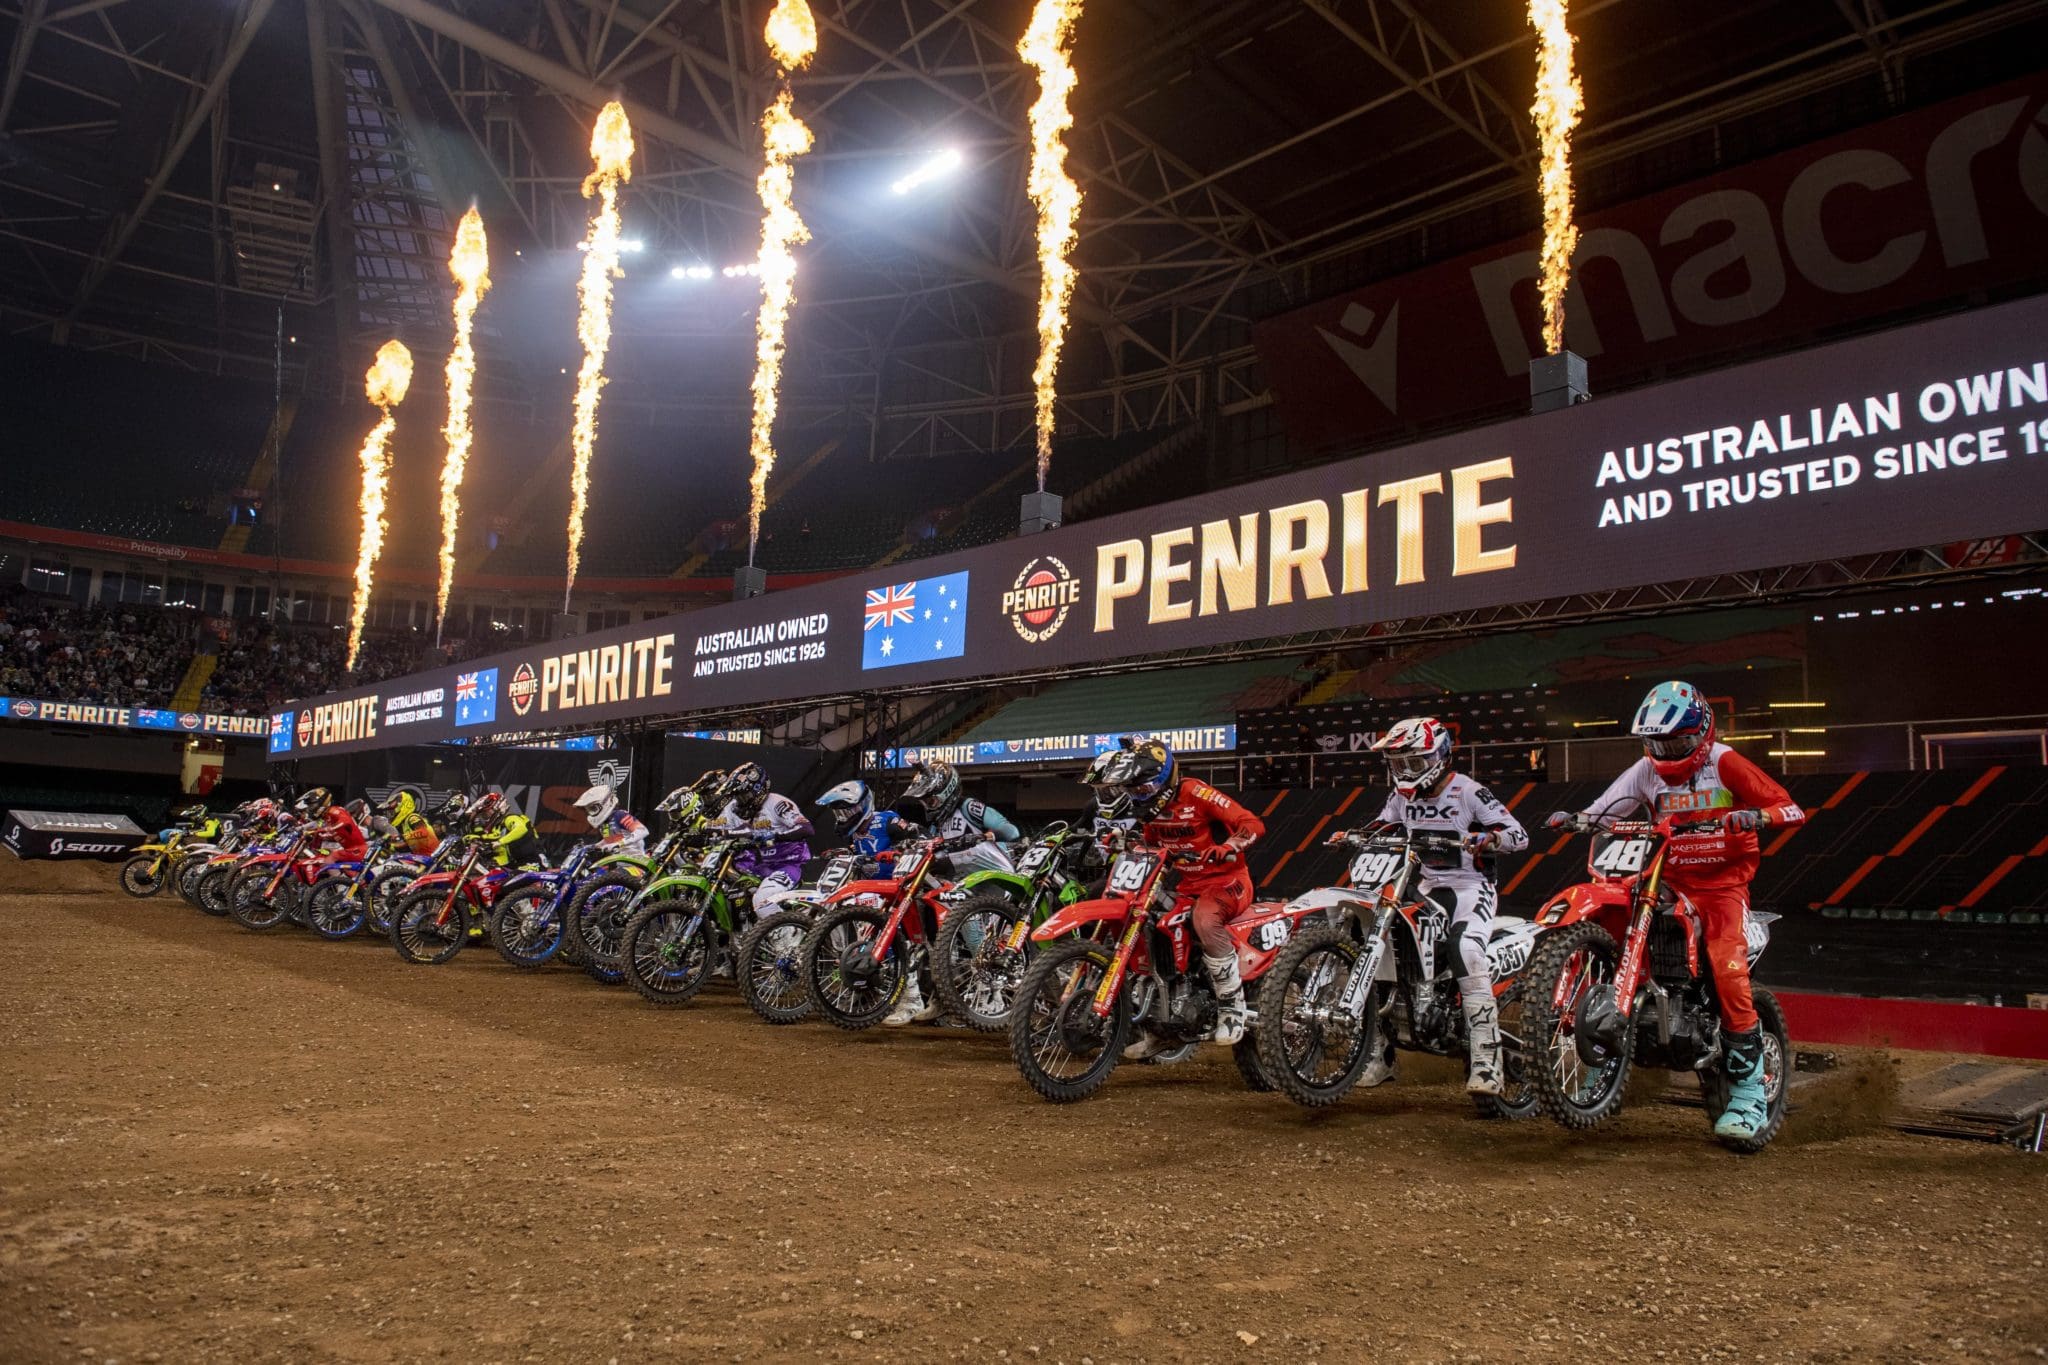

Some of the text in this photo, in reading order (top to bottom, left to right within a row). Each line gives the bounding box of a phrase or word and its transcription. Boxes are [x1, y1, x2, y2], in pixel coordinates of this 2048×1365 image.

[1595, 392, 1902, 488] AUSTRALIAN
[1598, 489, 1673, 528] AND
[1683, 454, 1861, 513] TRUSTED
[1874, 426, 2009, 480] SINCE
[130, 541, 187, 560] Principality
[1093, 456, 1517, 633] PENRITE
[1001, 578, 1080, 615] PENRITE
[694, 613, 829, 656] AUSTRALIAN OWNED
[541, 633, 676, 713] PENRITE
[693, 640, 826, 678] AND TRUSTED SINCE 1926
[386, 688, 444, 712] AUSTRALIAN OWNED
[509, 678, 538, 698] PENRITE
[40, 703, 130, 726] PENRITE
[313, 695, 379, 746] PENRITE
[1661, 790, 1713, 811] LEATT
[64, 843, 126, 853] SCOTT
[1594, 839, 1652, 872] 48
[1680, 856, 1725, 867] HONDA
[1110, 861, 1152, 890] 99
[1350, 852, 1402, 884] 891
[1261, 919, 1291, 951] 99
